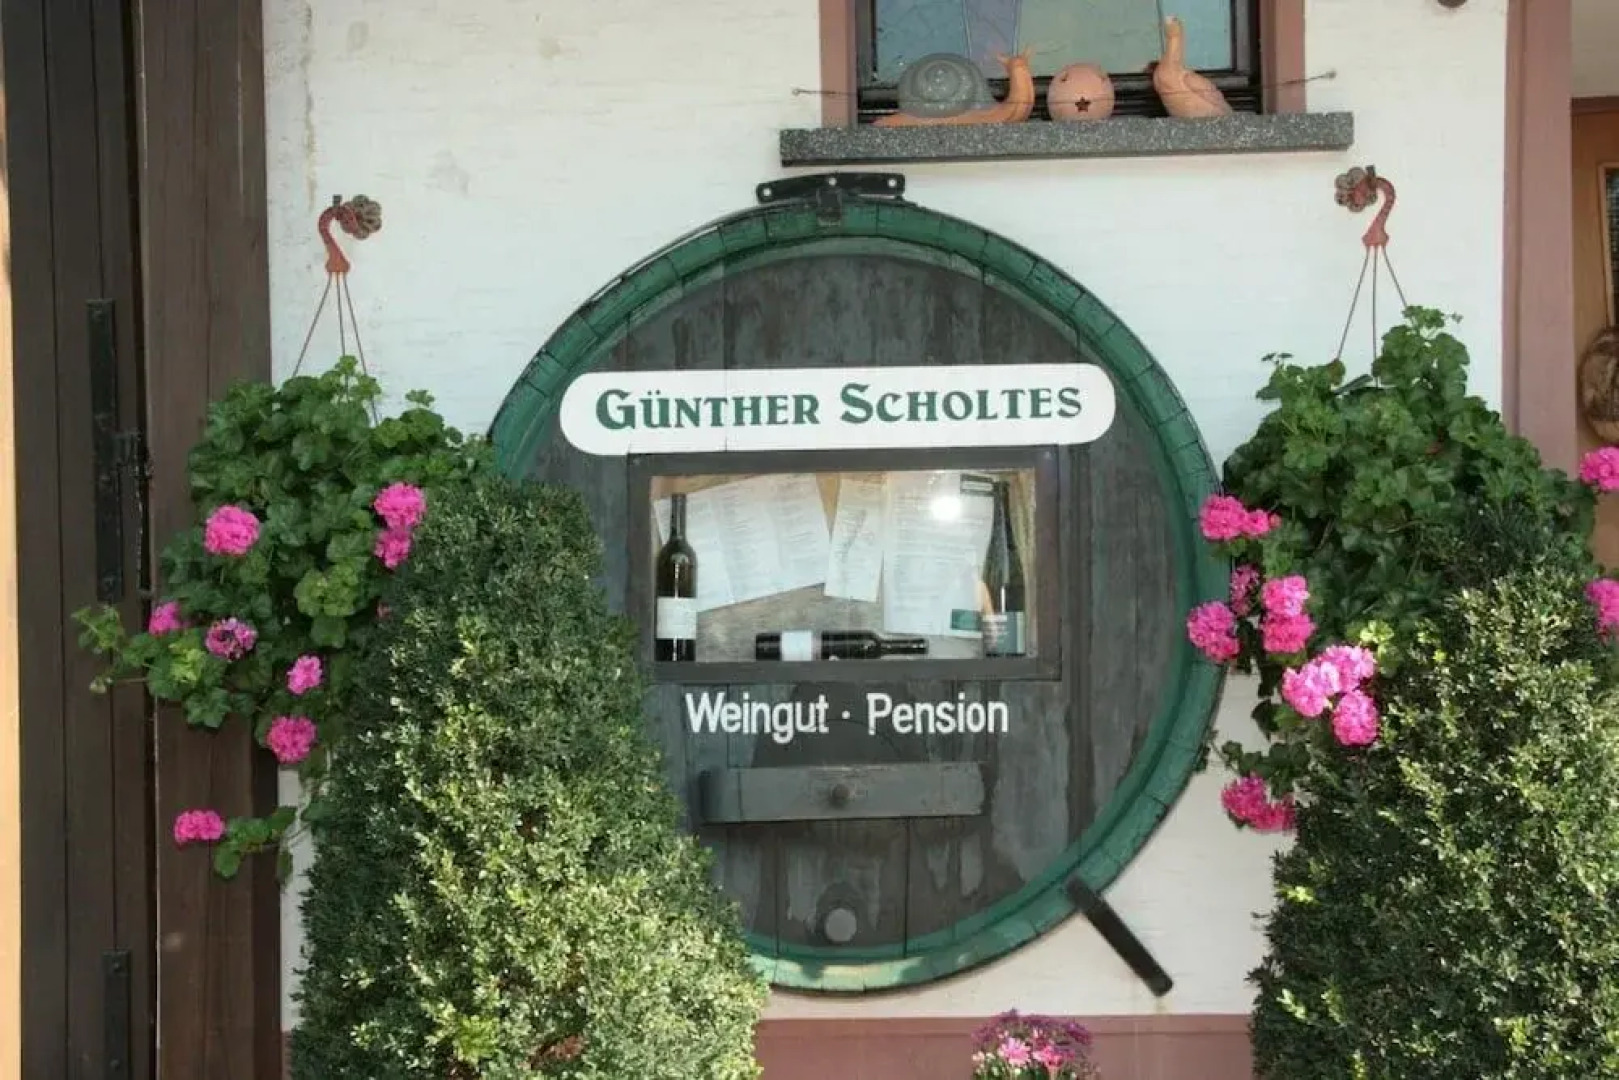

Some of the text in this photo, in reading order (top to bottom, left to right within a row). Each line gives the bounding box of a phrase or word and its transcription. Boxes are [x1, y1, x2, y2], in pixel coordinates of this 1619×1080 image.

[596, 383, 1082, 430] GÜNTHER SCHOLTES
[685, 691, 829, 744] Weingut
[866, 691, 1009, 735] Pension
